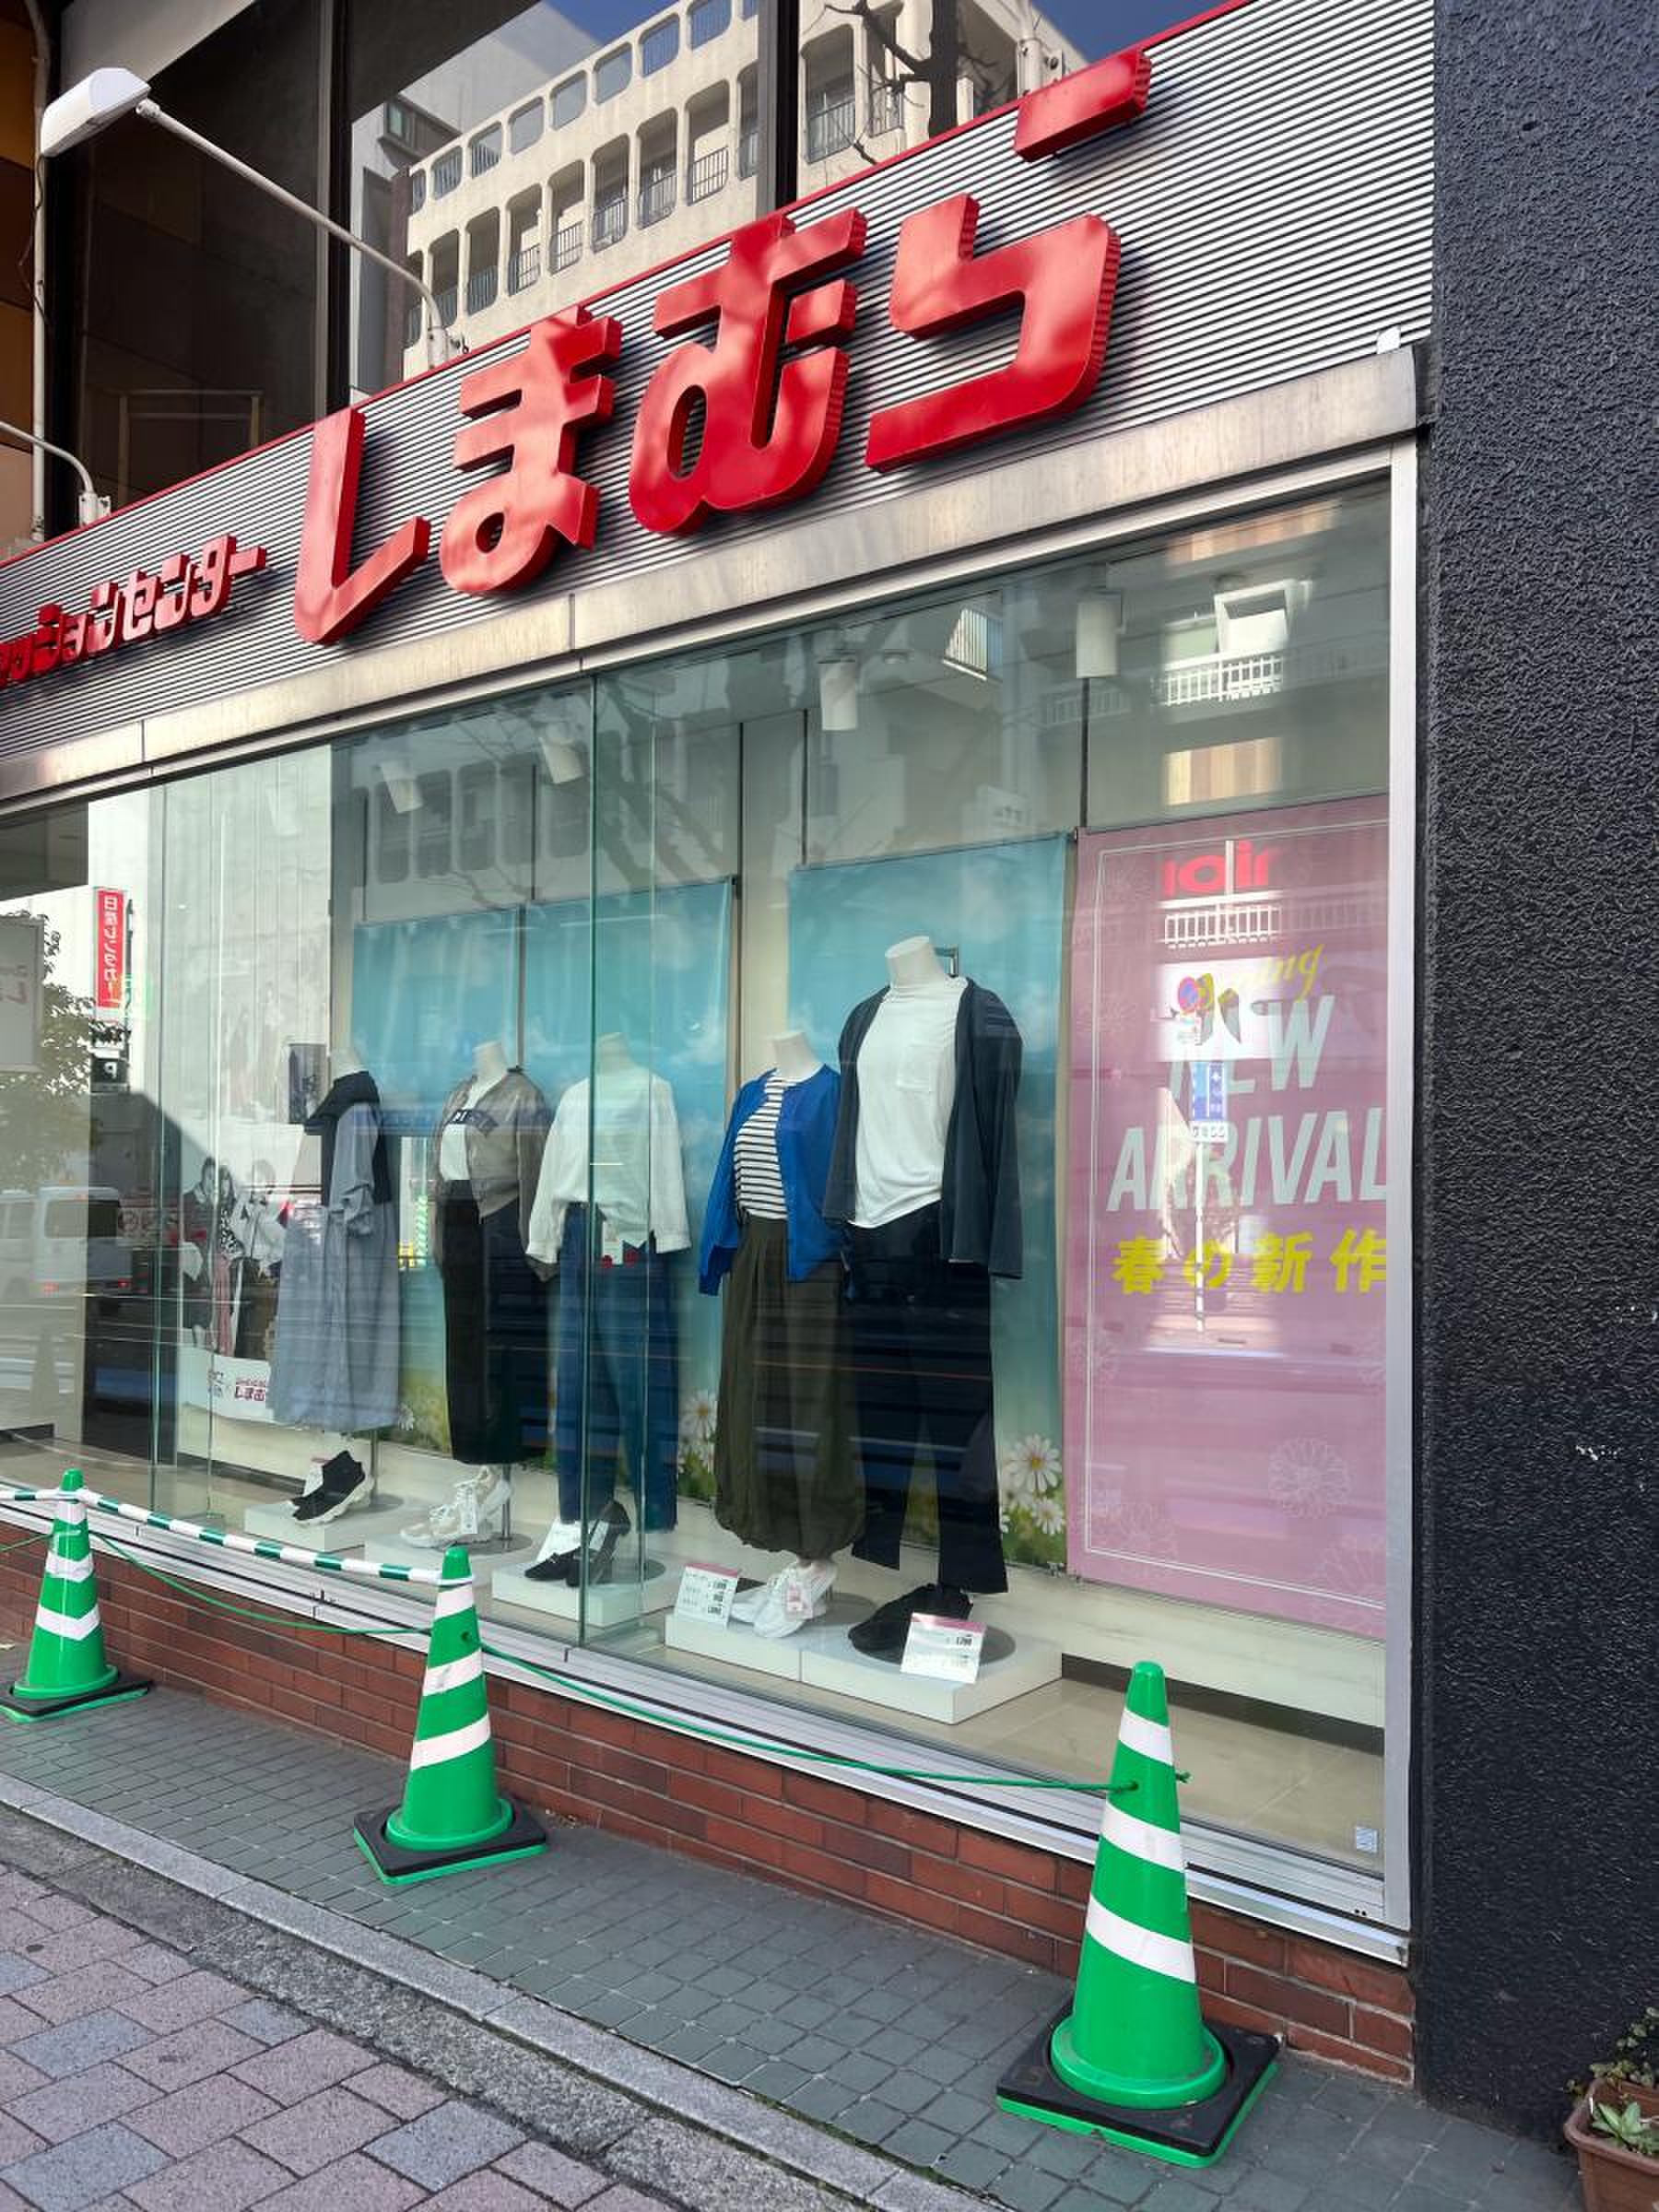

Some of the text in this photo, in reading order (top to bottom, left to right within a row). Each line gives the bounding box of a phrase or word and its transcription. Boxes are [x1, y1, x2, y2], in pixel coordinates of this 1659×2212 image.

[293, 49, 1152, 644] しまむら
[1108, 1106, 1387, 1212] ARRIVAL
[1111, 1227, 1387, 1294] 春の新作
